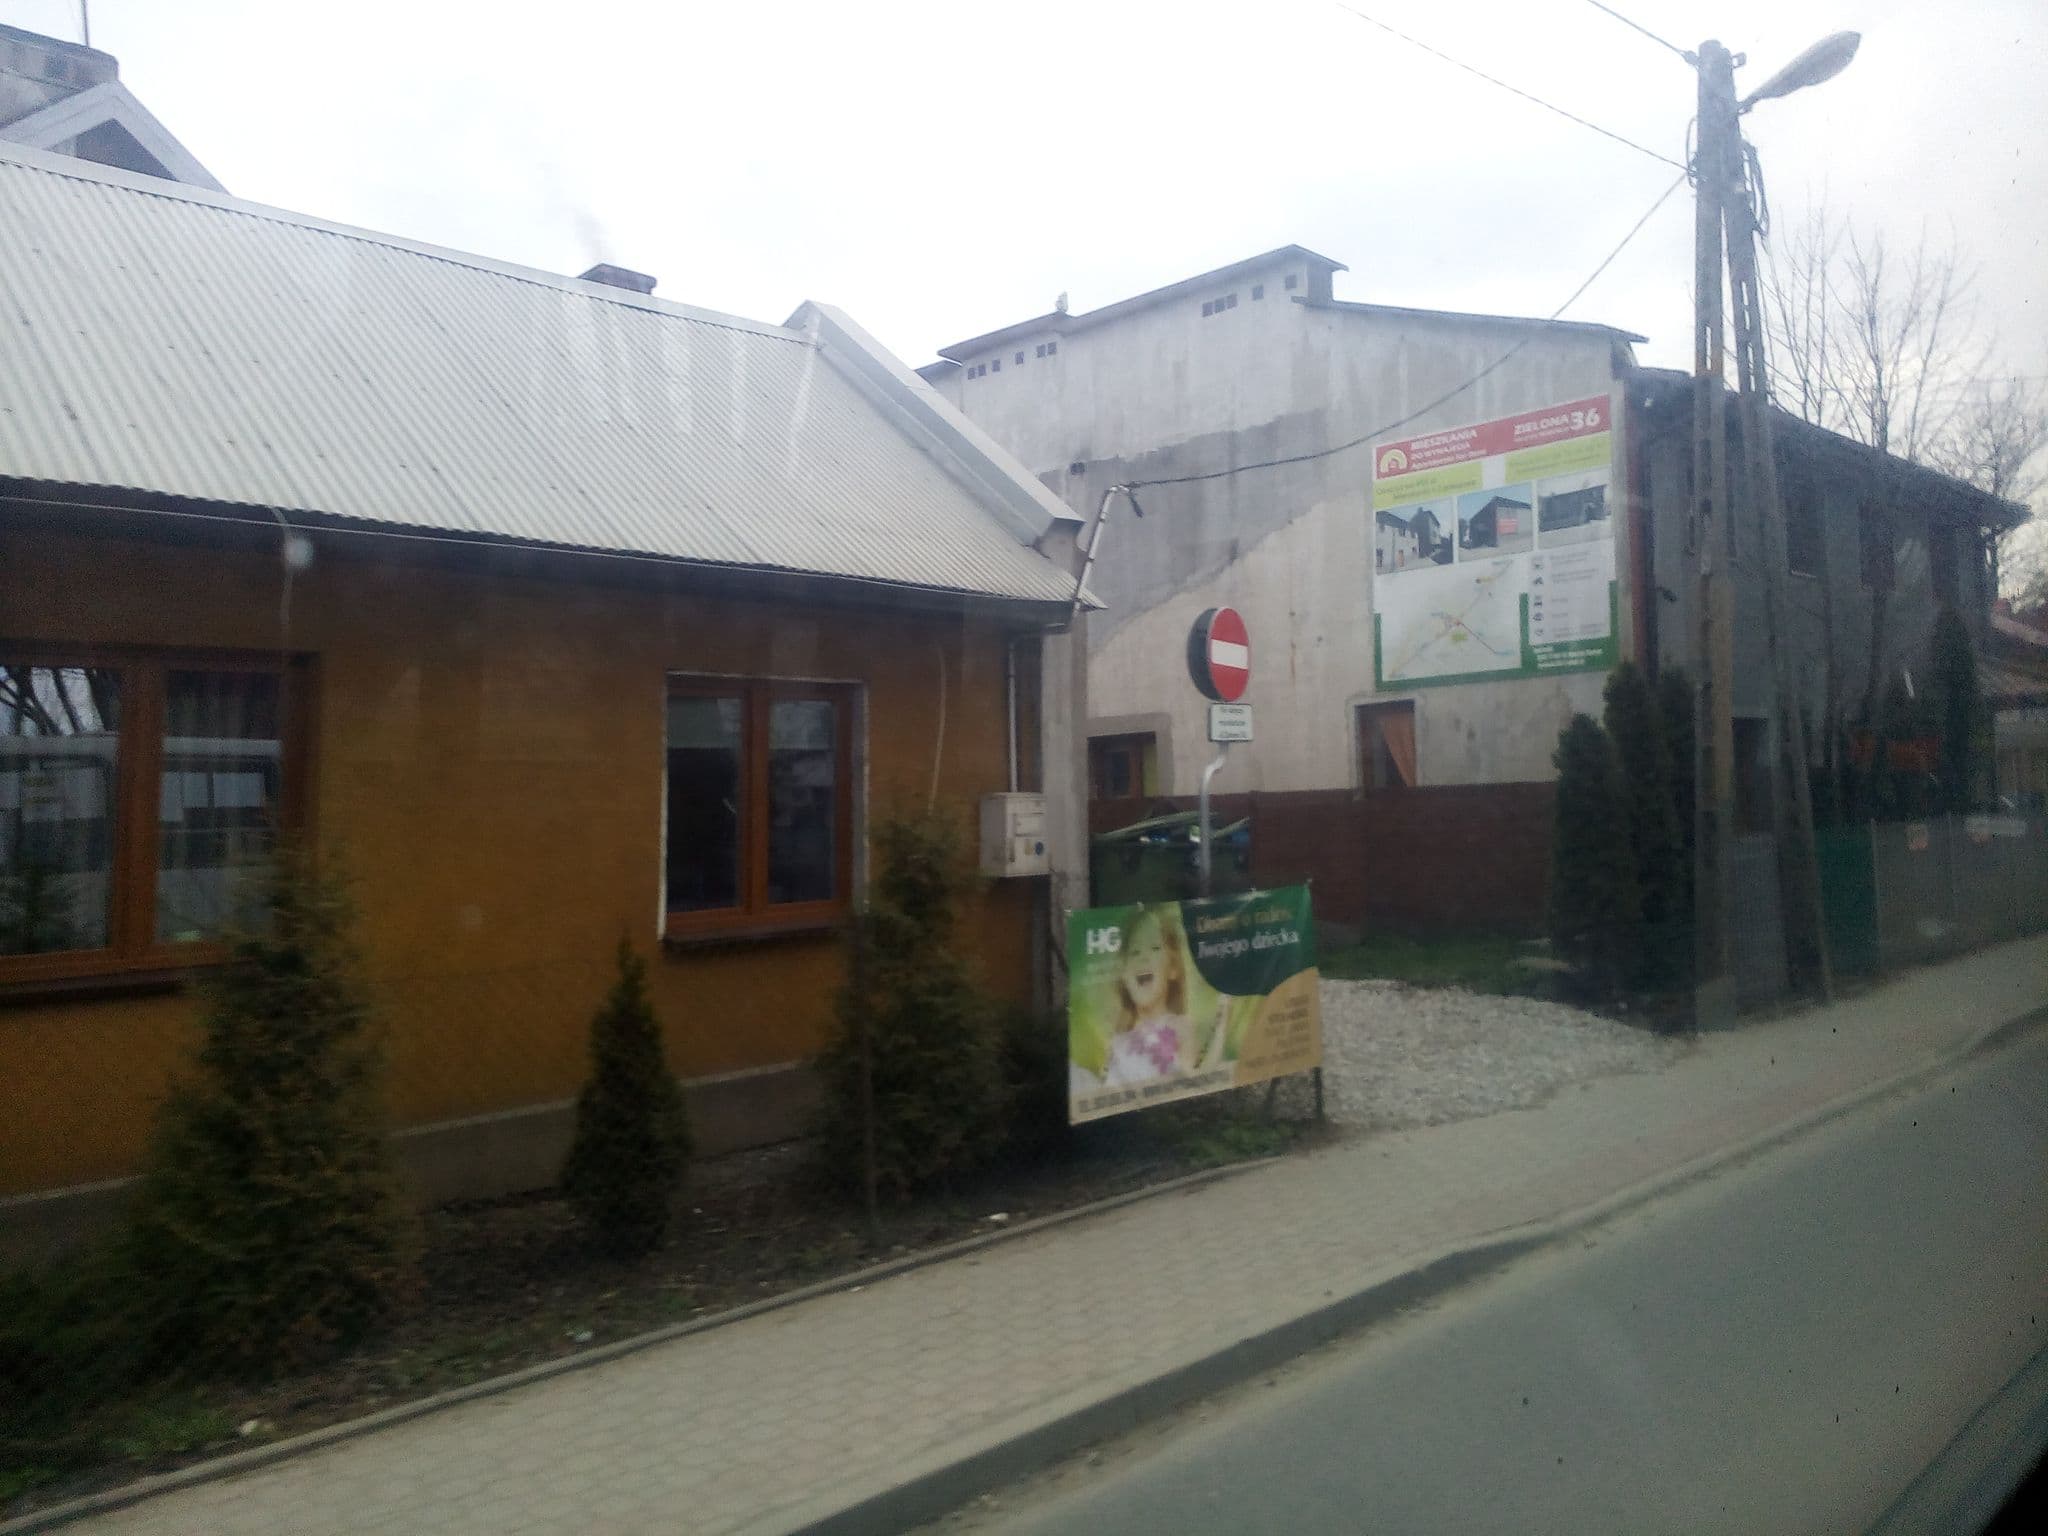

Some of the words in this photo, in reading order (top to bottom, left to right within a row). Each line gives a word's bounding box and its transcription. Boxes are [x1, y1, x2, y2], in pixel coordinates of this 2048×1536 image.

[1514, 414, 1569, 434] ZIELONA
[1570, 408, 1600, 430] 36
[1086, 925, 1121, 954] HG
[1198, 938, 1249, 959] Twojego
[1252, 927, 1299, 949] dziecka
